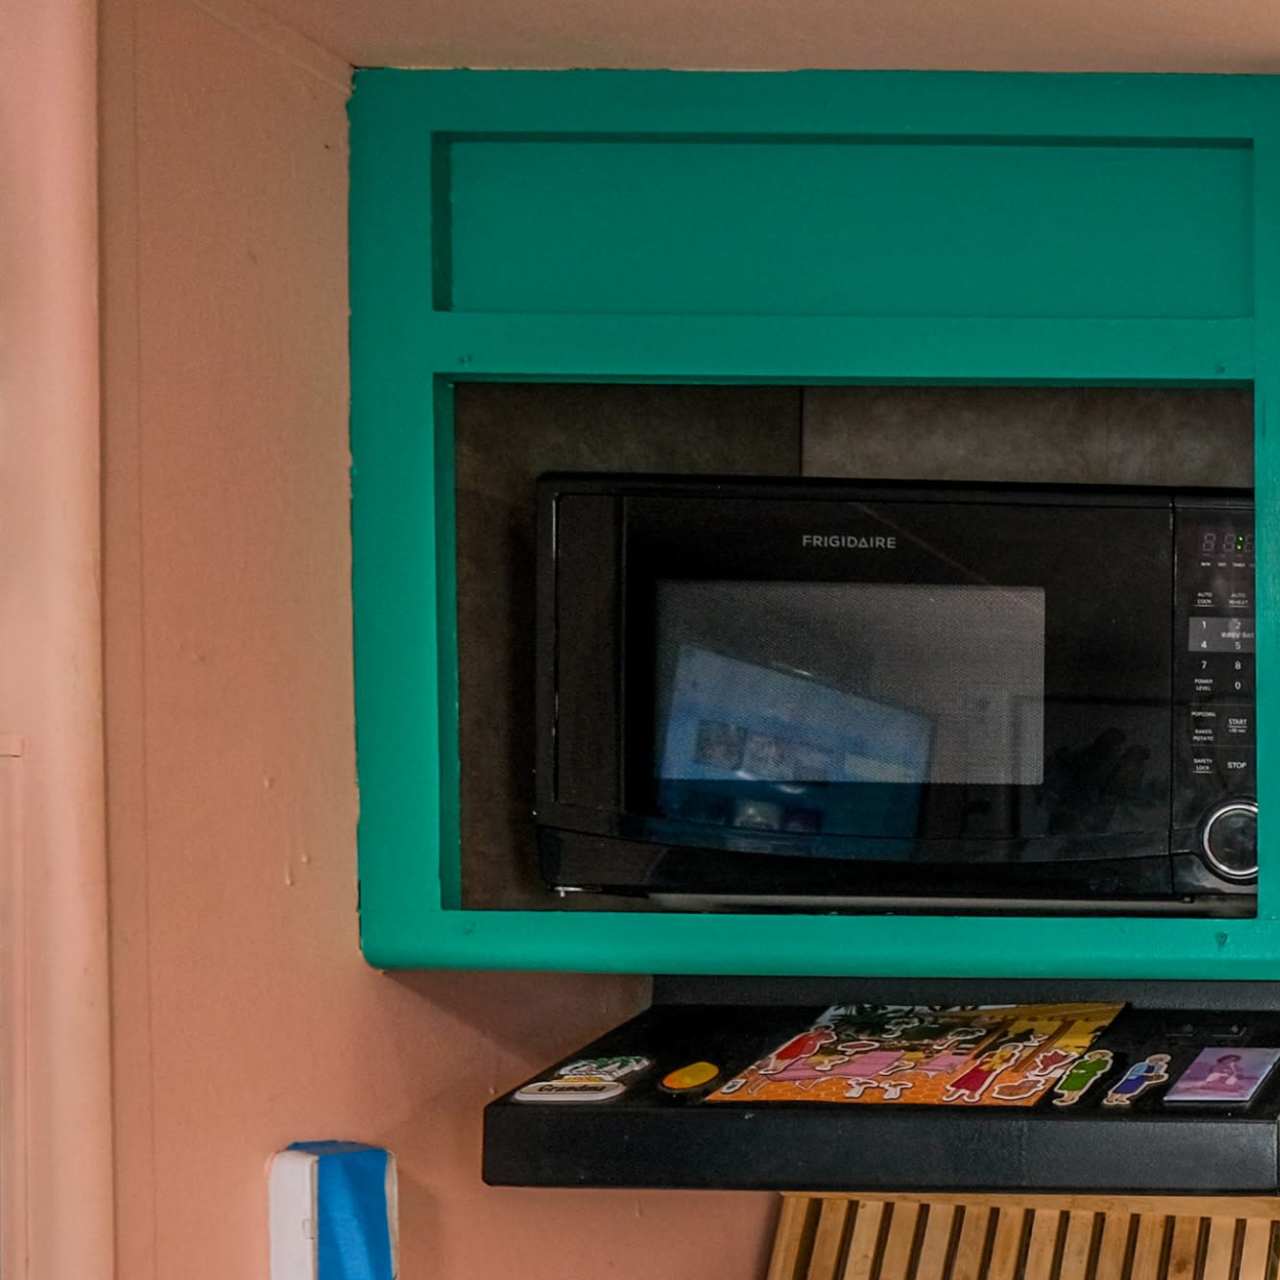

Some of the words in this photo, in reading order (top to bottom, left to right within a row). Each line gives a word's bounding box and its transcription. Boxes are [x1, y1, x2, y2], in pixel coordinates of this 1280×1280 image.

[801, 534, 897, 549] FRIGIDAIRE
[1201, 640, 1208, 649] 4
[1201, 660, 1207, 670] 7
[1234, 660, 1241, 670] 8
[1227, 761, 1247, 769] STOP
